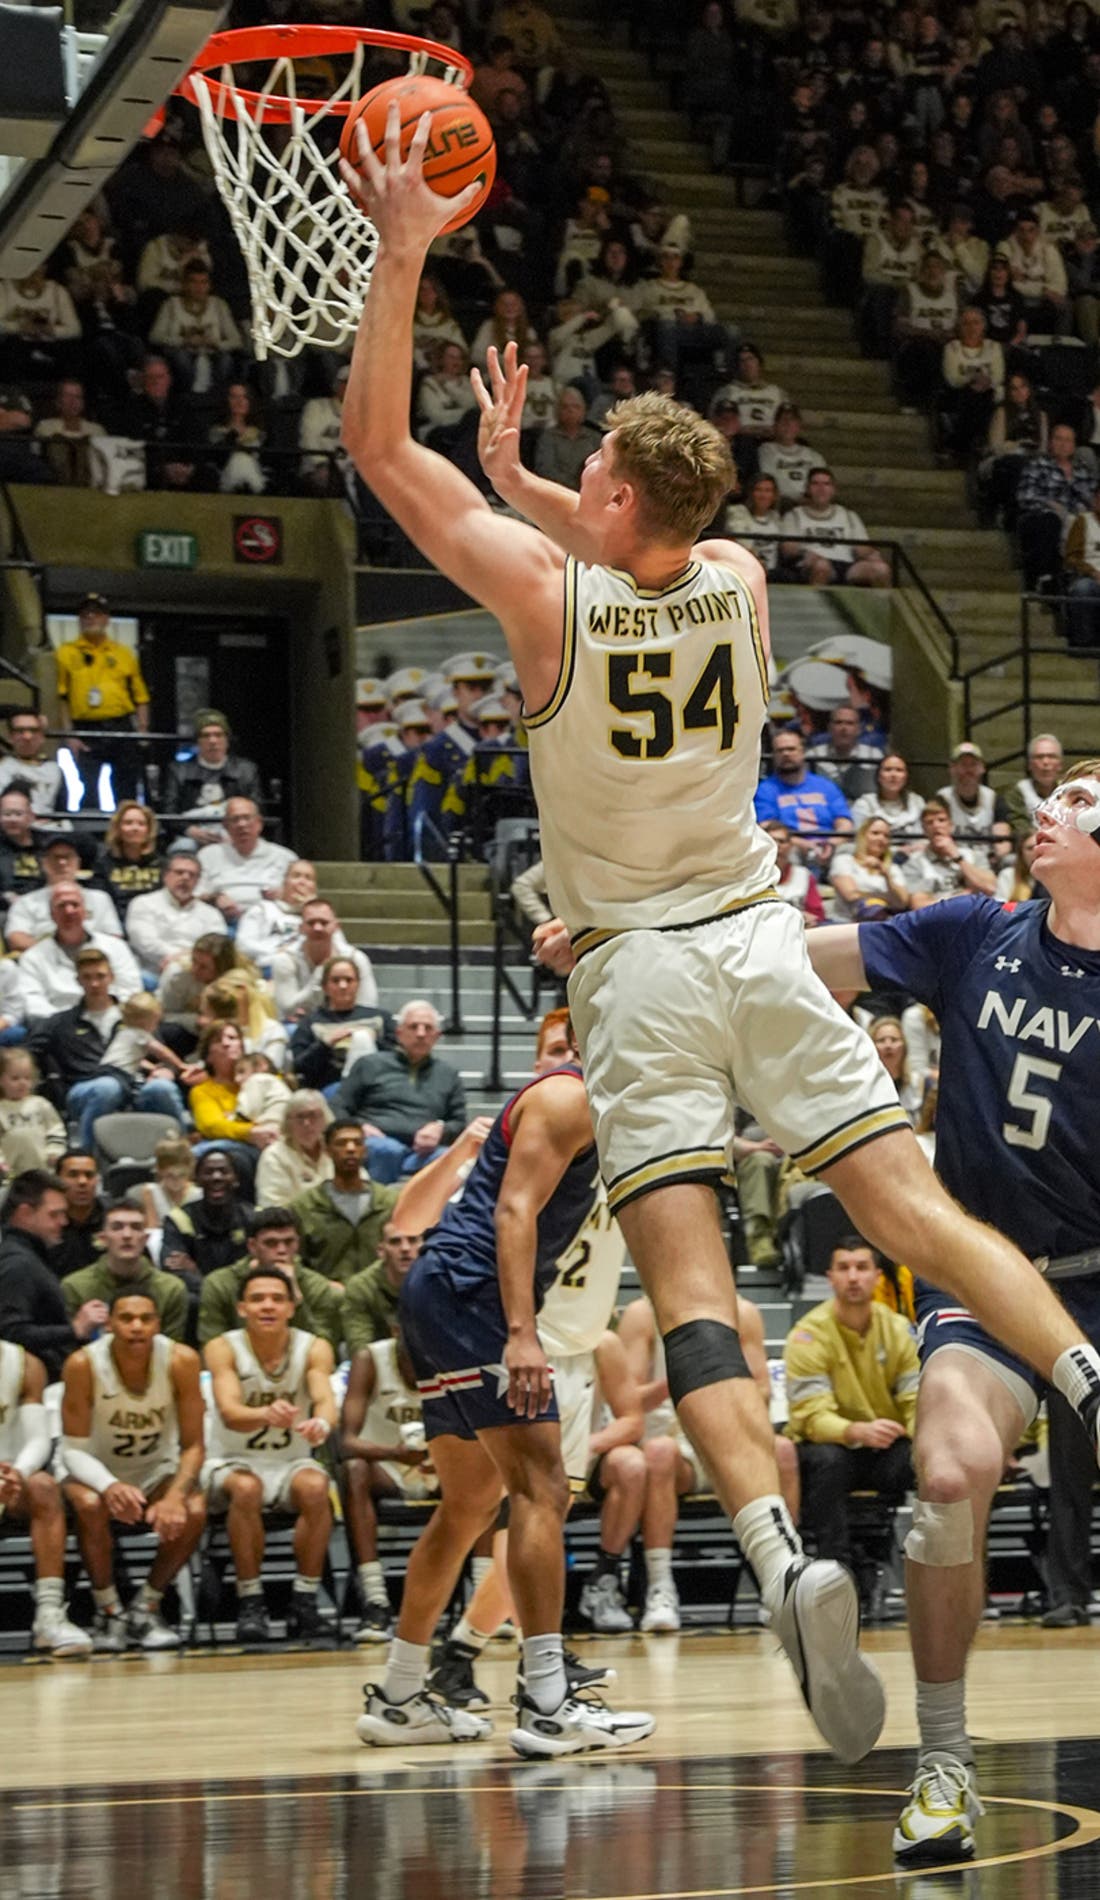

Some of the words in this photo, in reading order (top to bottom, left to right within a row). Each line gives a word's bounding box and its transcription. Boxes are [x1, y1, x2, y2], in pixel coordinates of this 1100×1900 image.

[146, 534, 194, 564] EXIT
[589, 605, 658, 637] WEST
[667, 591, 742, 632] POINT
[605, 640, 740, 760] 54
[977, 990, 1100, 1053] NAV
[1003, 1052, 1063, 1151] 5
[108, 1406, 166, 1430] ARMY
[246, 1425, 292, 1450] 23
